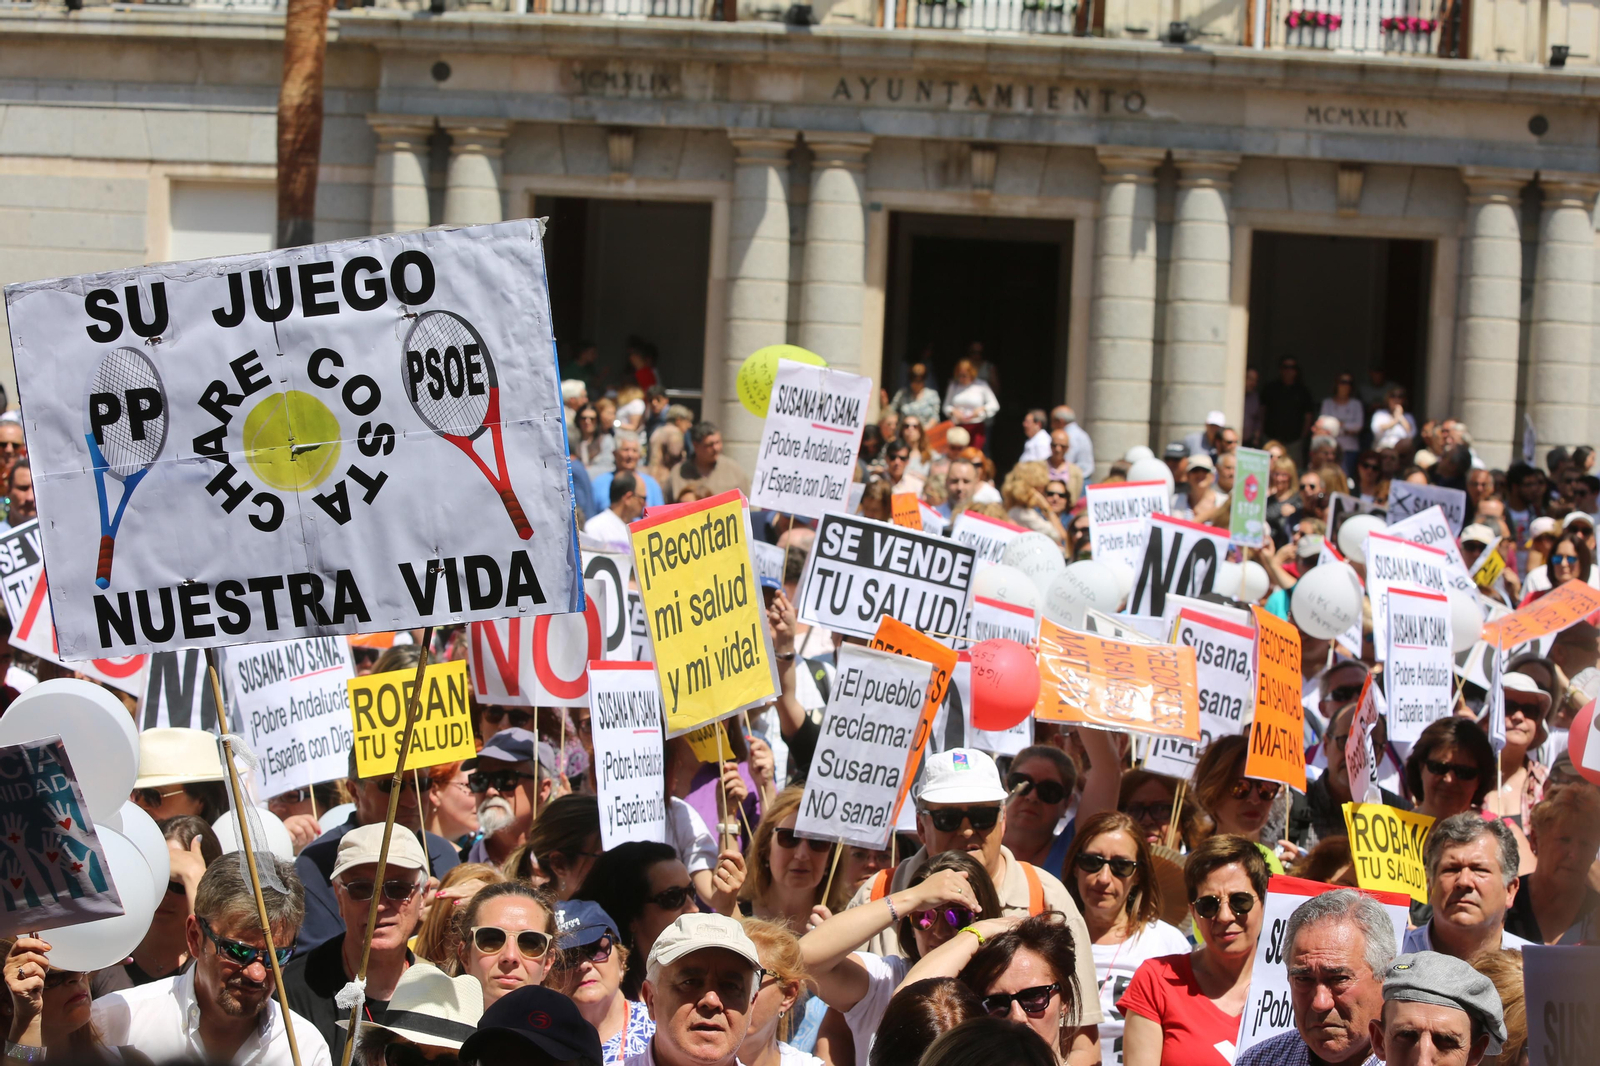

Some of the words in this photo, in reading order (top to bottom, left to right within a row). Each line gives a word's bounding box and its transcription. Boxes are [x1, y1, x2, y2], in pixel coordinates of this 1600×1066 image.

[832, 77, 1146, 113] AYUNTAMIENTO
[1305, 106, 1407, 129] MCMXLIX
[84, 281, 169, 343] SU
[212, 250, 436, 328] JUEGO
[406, 343, 486, 403] PSOE
[89, 388, 164, 445] PP
[775, 384, 818, 420] SUSANA
[814, 391, 833, 422] NO
[307, 347, 395, 525] COSTA
[764, 431, 801, 460] ¡Pobre
[803, 436, 851, 466] Andalucía
[758, 470, 768, 495] y
[768, 467, 802, 498] España
[802, 476, 820, 496] con
[820, 475, 847, 501] Díaz!
[1094, 499, 1126, 523] SUSANA
[1129, 498, 1139, 519] NO
[0, 537, 28, 575] SE
[641, 512, 739, 591] ¡Recortan
[822, 522, 863, 561] SE
[873, 532, 973, 588] VENDE
[1130, 526, 1217, 617] NO
[1375, 554, 1410, 580] SUSANA
[1410, 559, 1422, 584] NO
[93, 569, 371, 649] NUESTRA
[398, 549, 548, 616] VIDA
[654, 590, 682, 642] mi
[689, 563, 748, 627] salud
[814, 567, 854, 616] TU
[857, 578, 958, 640] SALUD
[238, 649, 286, 694] SUSANA
[286, 642, 305, 678] NO
[305, 637, 346, 671] SANA.
[471, 590, 603, 700] NO
[667, 668, 679, 714] y
[686, 645, 711, 695] mi
[714, 623, 760, 681] vida!
[1181, 628, 1251, 681] Susana,
[1260, 624, 1299, 674] RECORTES
[250, 705, 287, 747] ¡Pobre
[290, 683, 350, 724] Andalucía
[353, 673, 466, 732] ROBAN
[598, 691, 627, 729] SUSANA
[627, 691, 640, 728] NO
[835, 668, 863, 702] ¡El
[861, 678, 922, 716] pueblo
[358, 732, 386, 761] TU
[394, 721, 469, 756] SALUD!
[826, 713, 913, 749] reclama:
[260, 756, 268, 786] y
[267, 738, 307, 777] España
[308, 733, 331, 759] con
[602, 750, 633, 790] ¡Pobre
[633, 745, 662, 779] Andalucía
[817, 749, 900, 788] Susana
[607, 804, 614, 836] y
[615, 794, 647, 834] España
[805, 789, 838, 820] NO
[840, 801, 893, 828] sana!
[1351, 812, 1429, 863] ROBAN
[1358, 856, 1381, 879] TU
[1386, 858, 1425, 891] SALUD!
